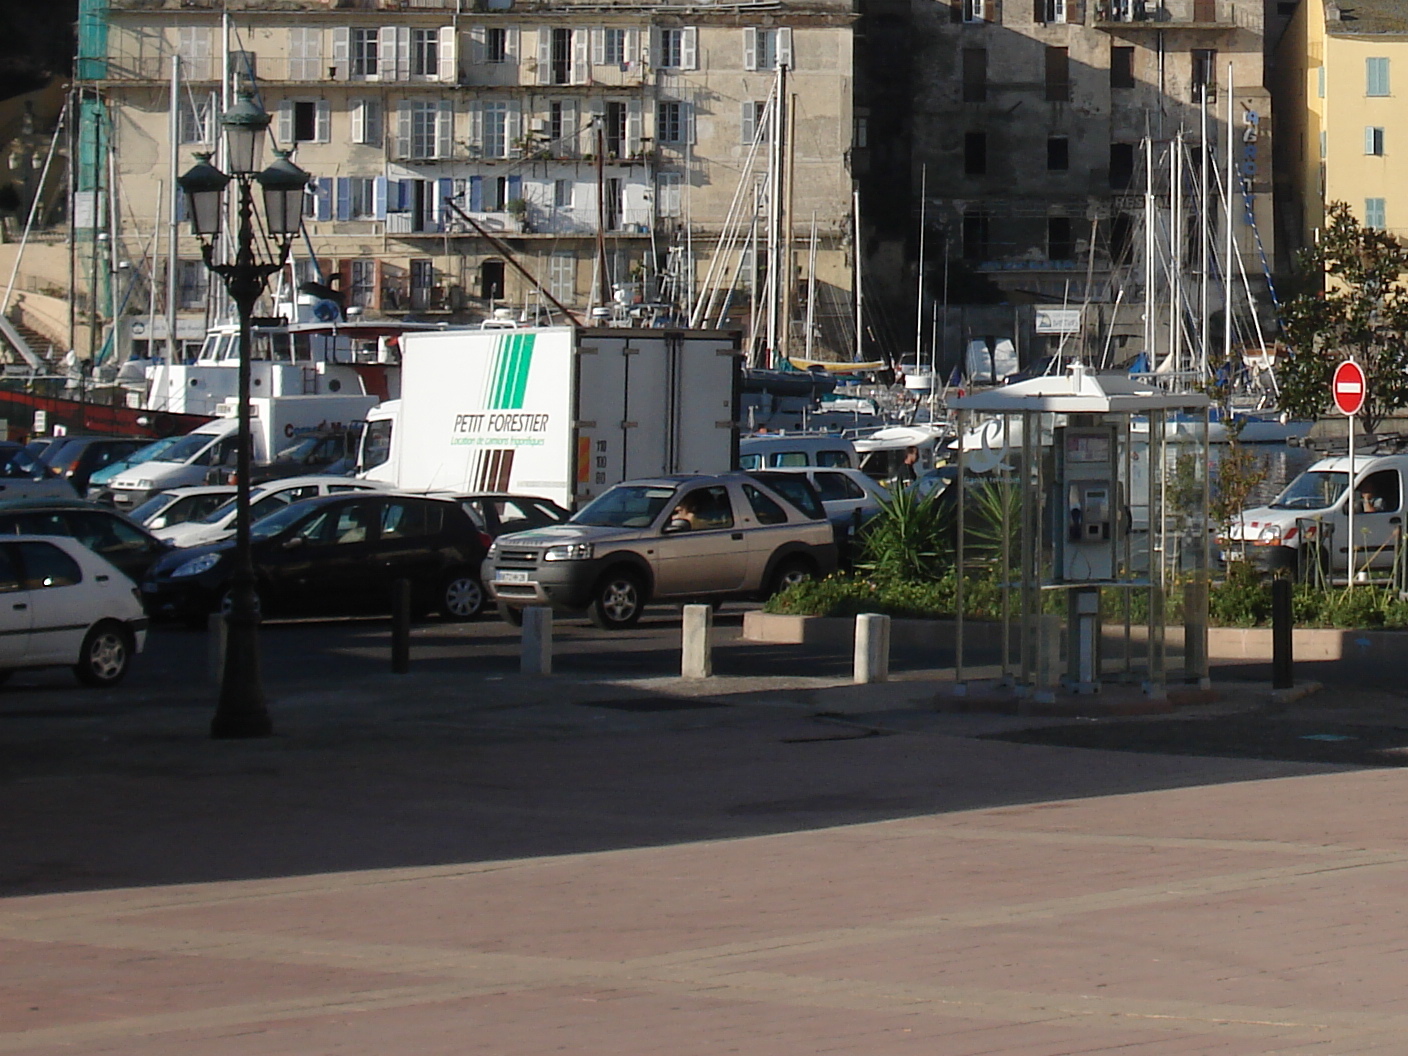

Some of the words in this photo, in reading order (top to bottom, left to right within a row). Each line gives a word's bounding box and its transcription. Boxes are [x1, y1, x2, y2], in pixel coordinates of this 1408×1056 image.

[454, 414, 485, 432] PETIT
[487, 413, 549, 432] FORESTIER
[450, 436, 475, 445] Location
[476, 436, 483, 445] de
